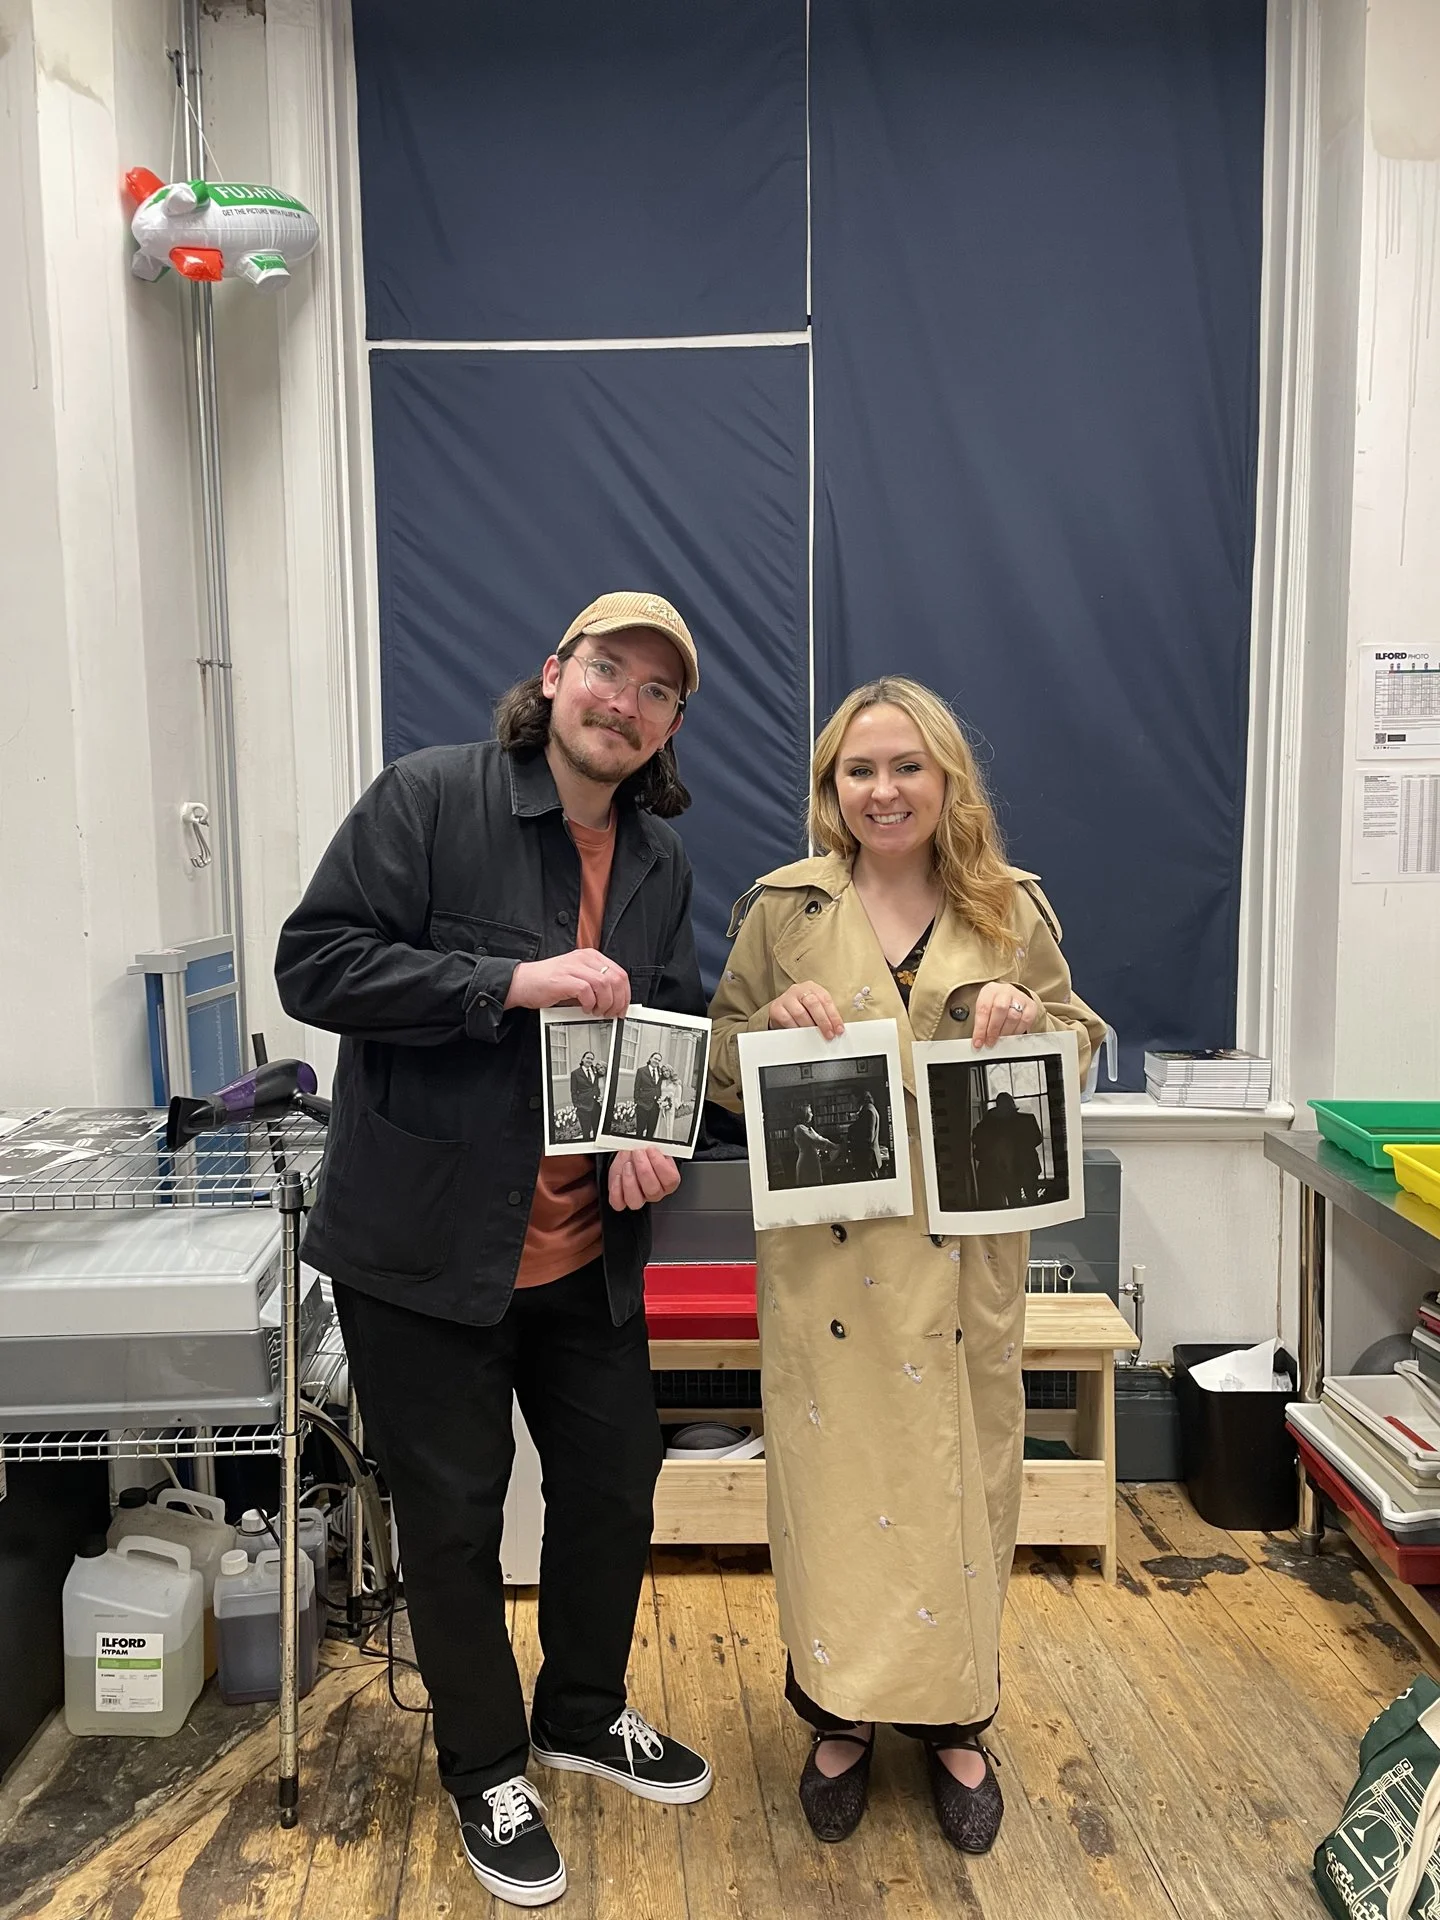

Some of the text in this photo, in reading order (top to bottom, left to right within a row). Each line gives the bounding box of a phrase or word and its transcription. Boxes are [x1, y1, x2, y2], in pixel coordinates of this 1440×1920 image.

[222, 209, 234, 217] GET
[246, 207, 269, 215] PICTURE
[1375, 652, 1407, 660] ILFORD
[101, 1637, 146, 1648] ILFORD
